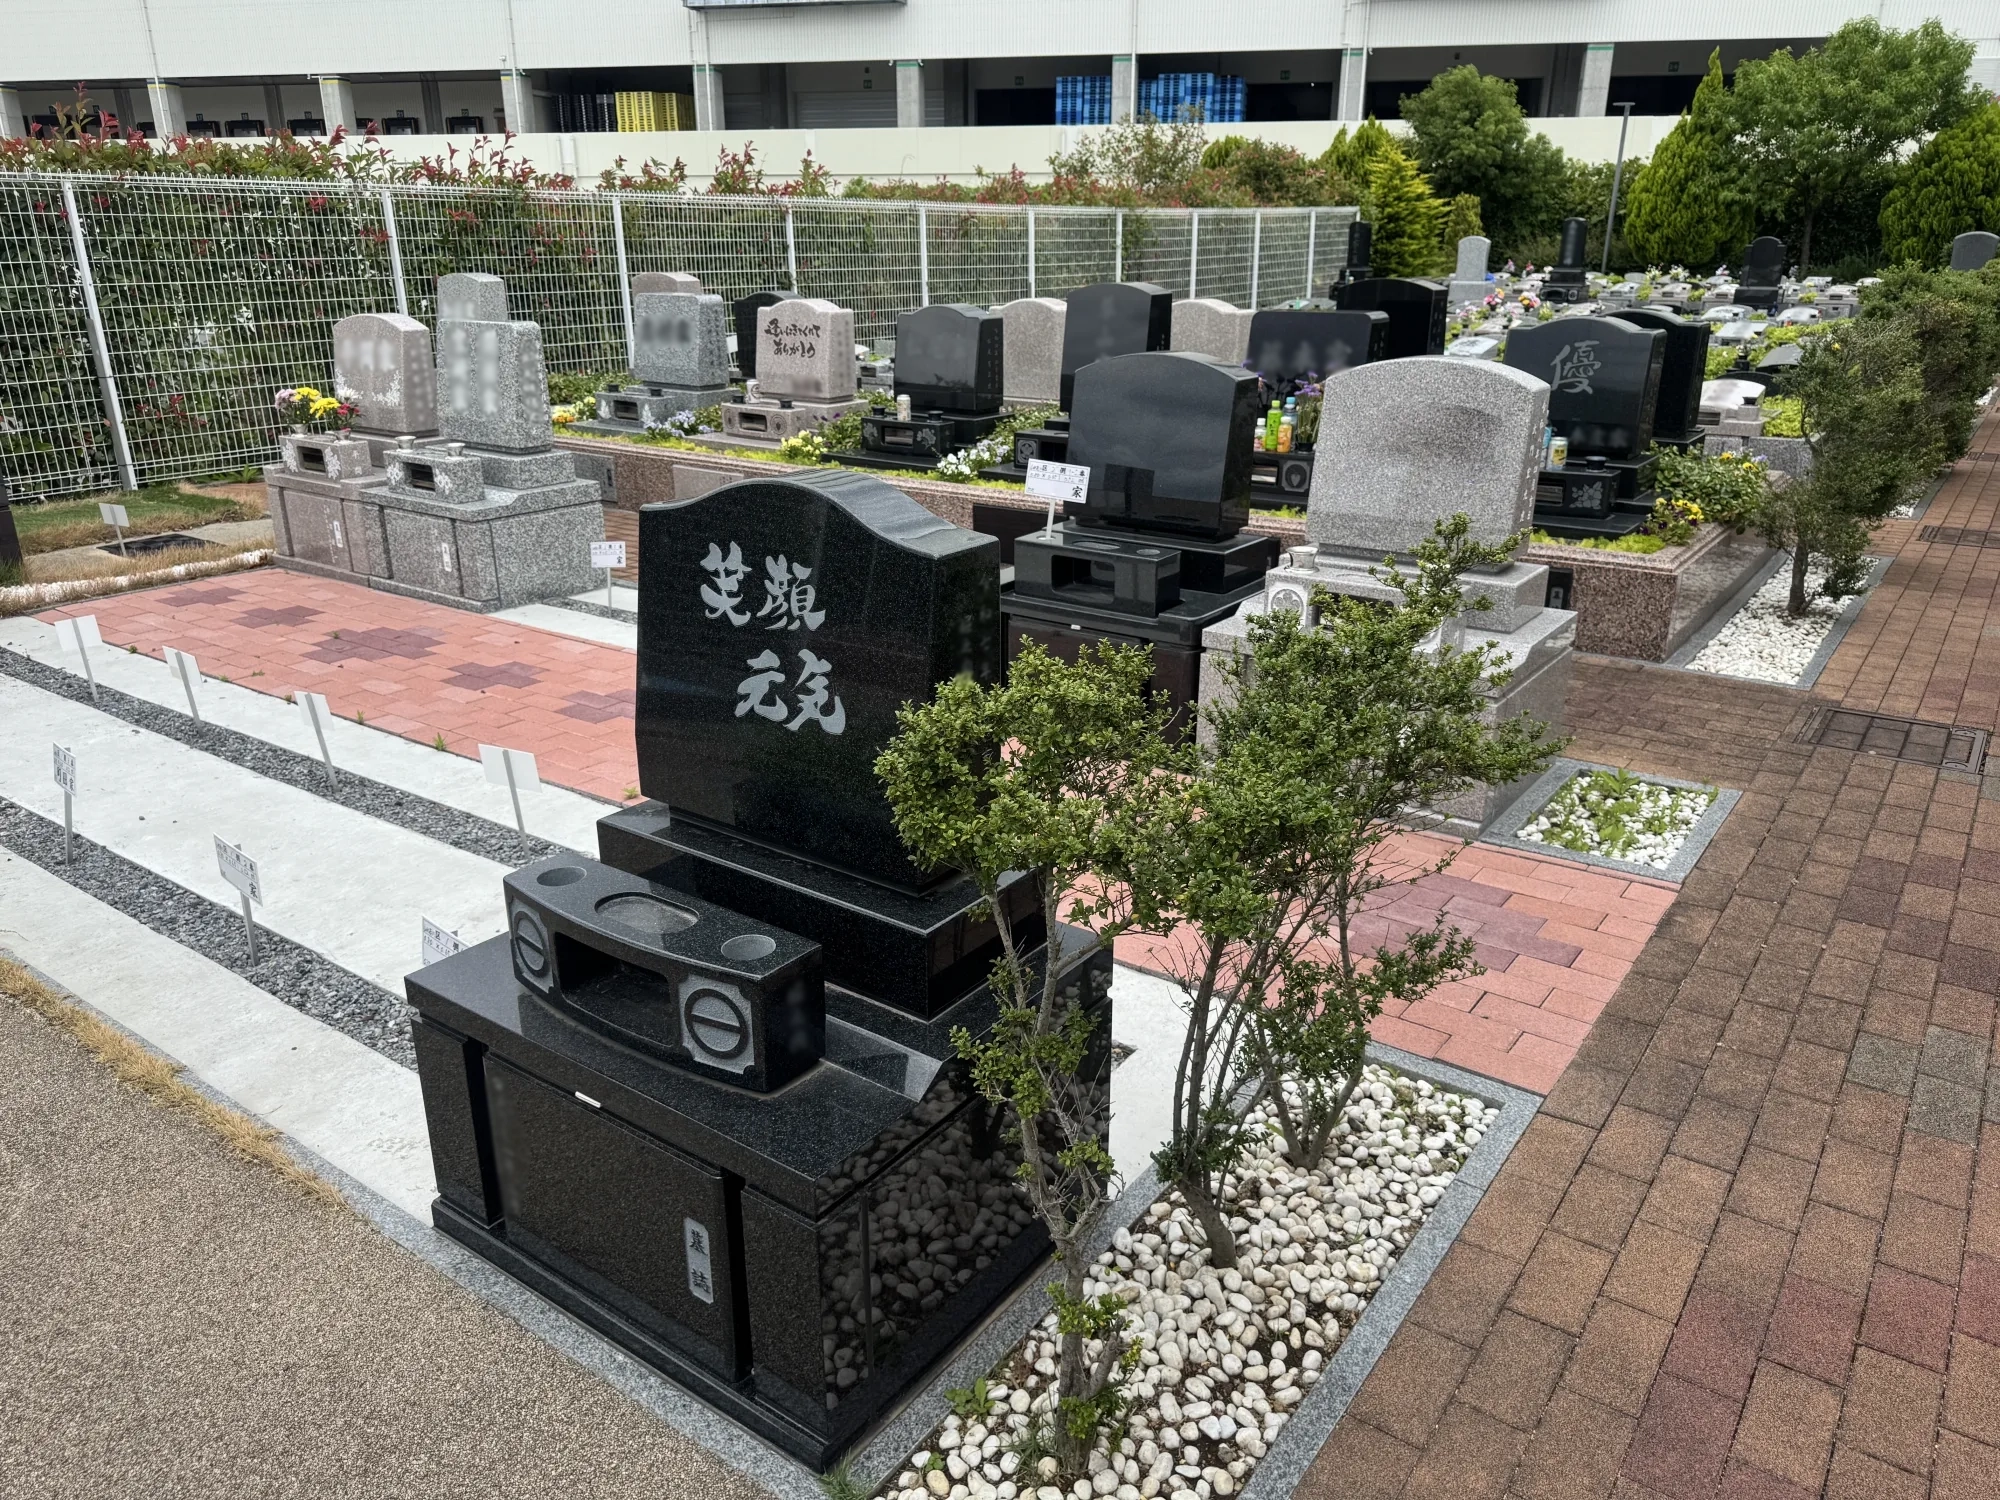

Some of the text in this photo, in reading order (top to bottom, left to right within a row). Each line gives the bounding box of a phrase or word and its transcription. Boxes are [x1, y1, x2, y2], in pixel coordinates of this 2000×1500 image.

[773, 338, 816, 358] ありがとう
[1549, 340, 1602, 394] 優
[1072, 485, 1083, 498] 家
[700, 541, 826, 631] 笑顔
[734, 649, 846, 735] 元気
[689, 1228, 711, 1294] 墓誌
